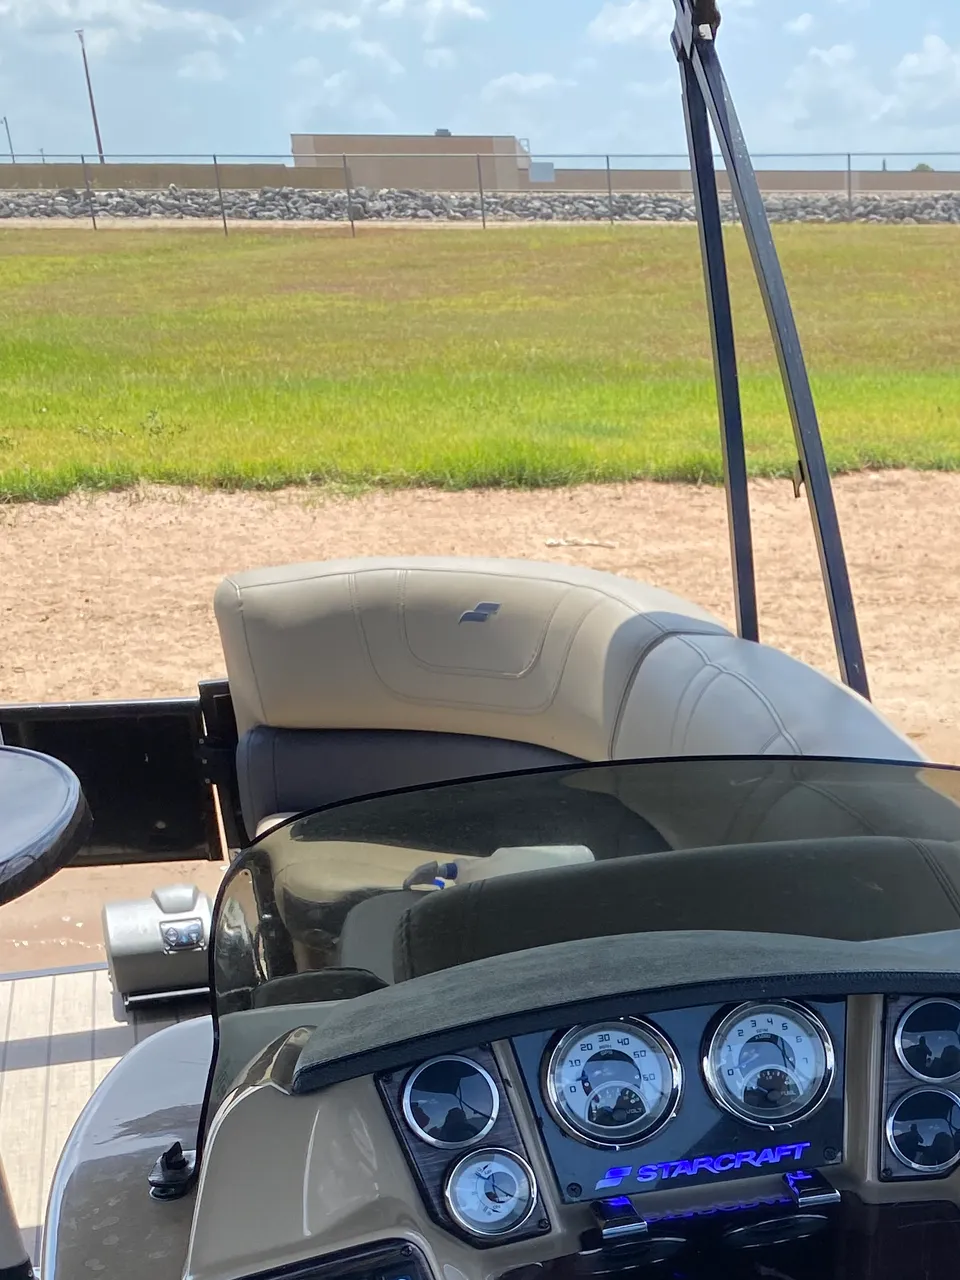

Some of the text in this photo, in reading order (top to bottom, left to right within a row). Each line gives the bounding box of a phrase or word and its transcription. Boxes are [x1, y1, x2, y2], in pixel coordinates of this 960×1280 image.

[750, 1020, 757, 1028] 3
[766, 1018, 773, 1026] 4
[781, 1022, 788, 1030] 5
[597, 1033, 610, 1042] 30
[616, 1037, 630, 1046] 40
[795, 1035, 803, 1043] 6
[580, 1043, 593, 1052] 20
[633, 1050, 647, 1059] 50
[569, 1059, 581, 1067] 10
[727, 1068, 734, 1076] 0
[642, 1073, 656, 1081] 60
[569, 1085, 577, 1093] 0
[636, 1142, 811, 1182] STARCRAFT
